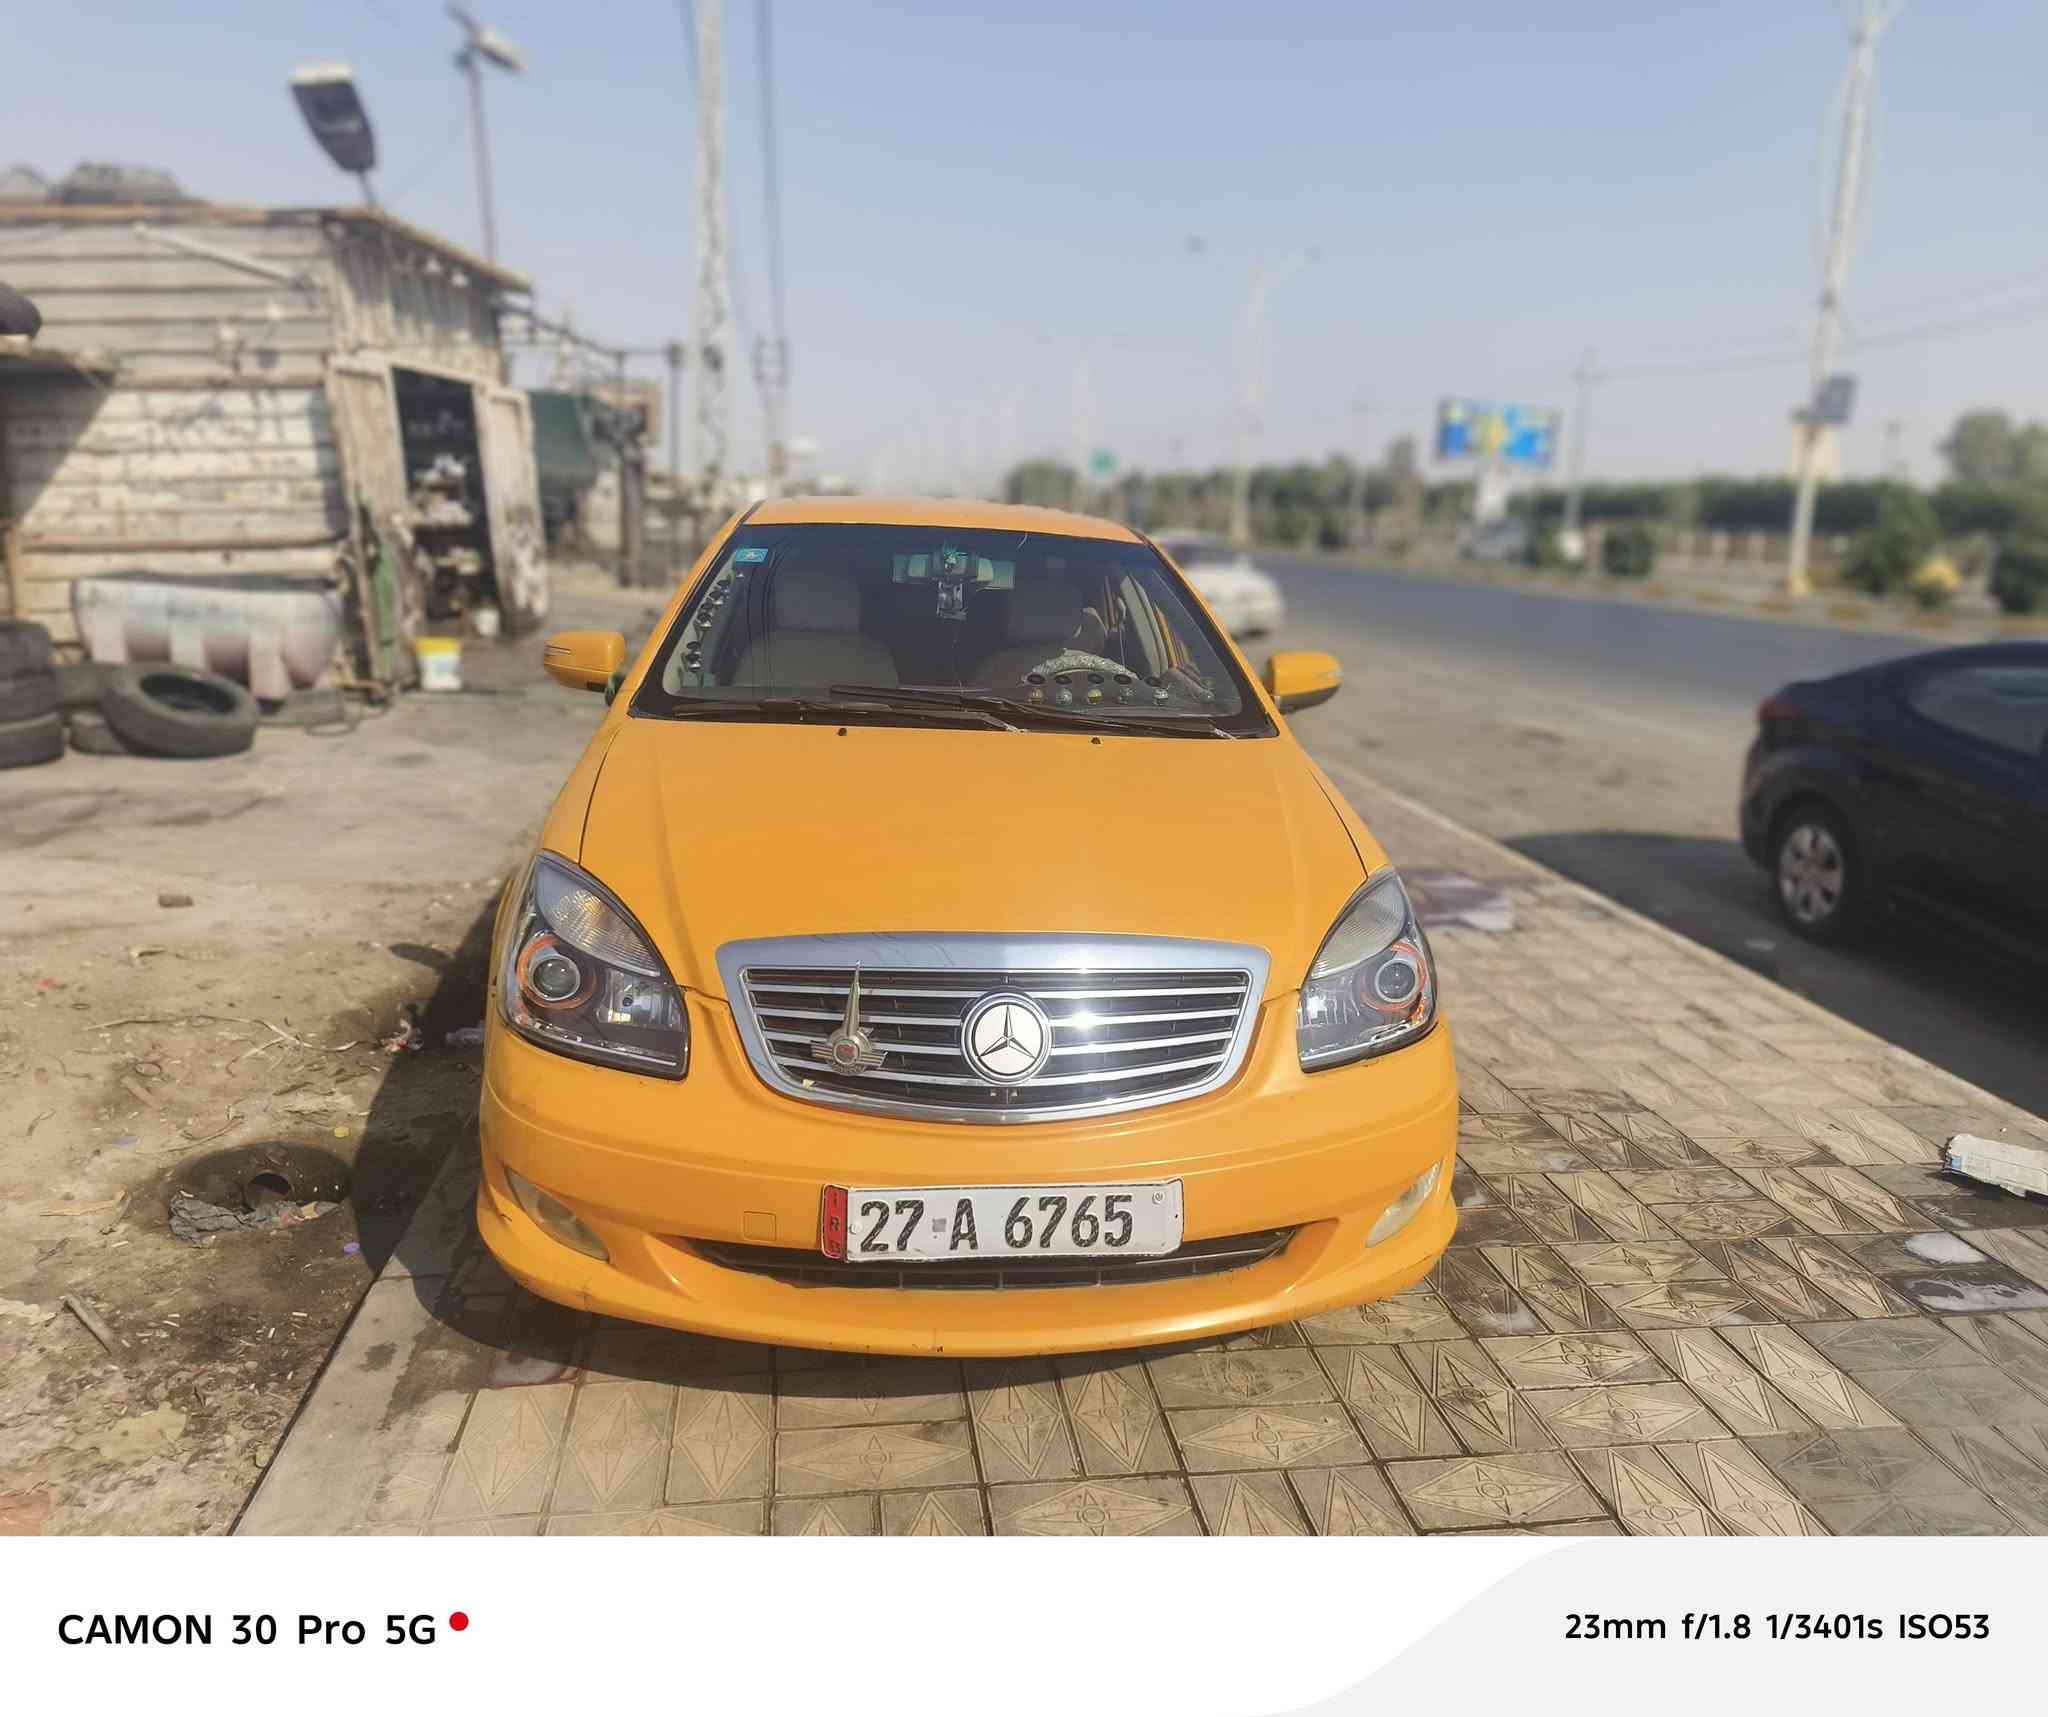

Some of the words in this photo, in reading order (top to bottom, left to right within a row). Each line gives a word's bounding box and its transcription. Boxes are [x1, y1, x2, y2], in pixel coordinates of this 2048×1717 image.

[860, 1199, 925, 1253] 27
[950, 1198, 979, 1251] A
[1004, 1194, 1133, 1249] 6765
